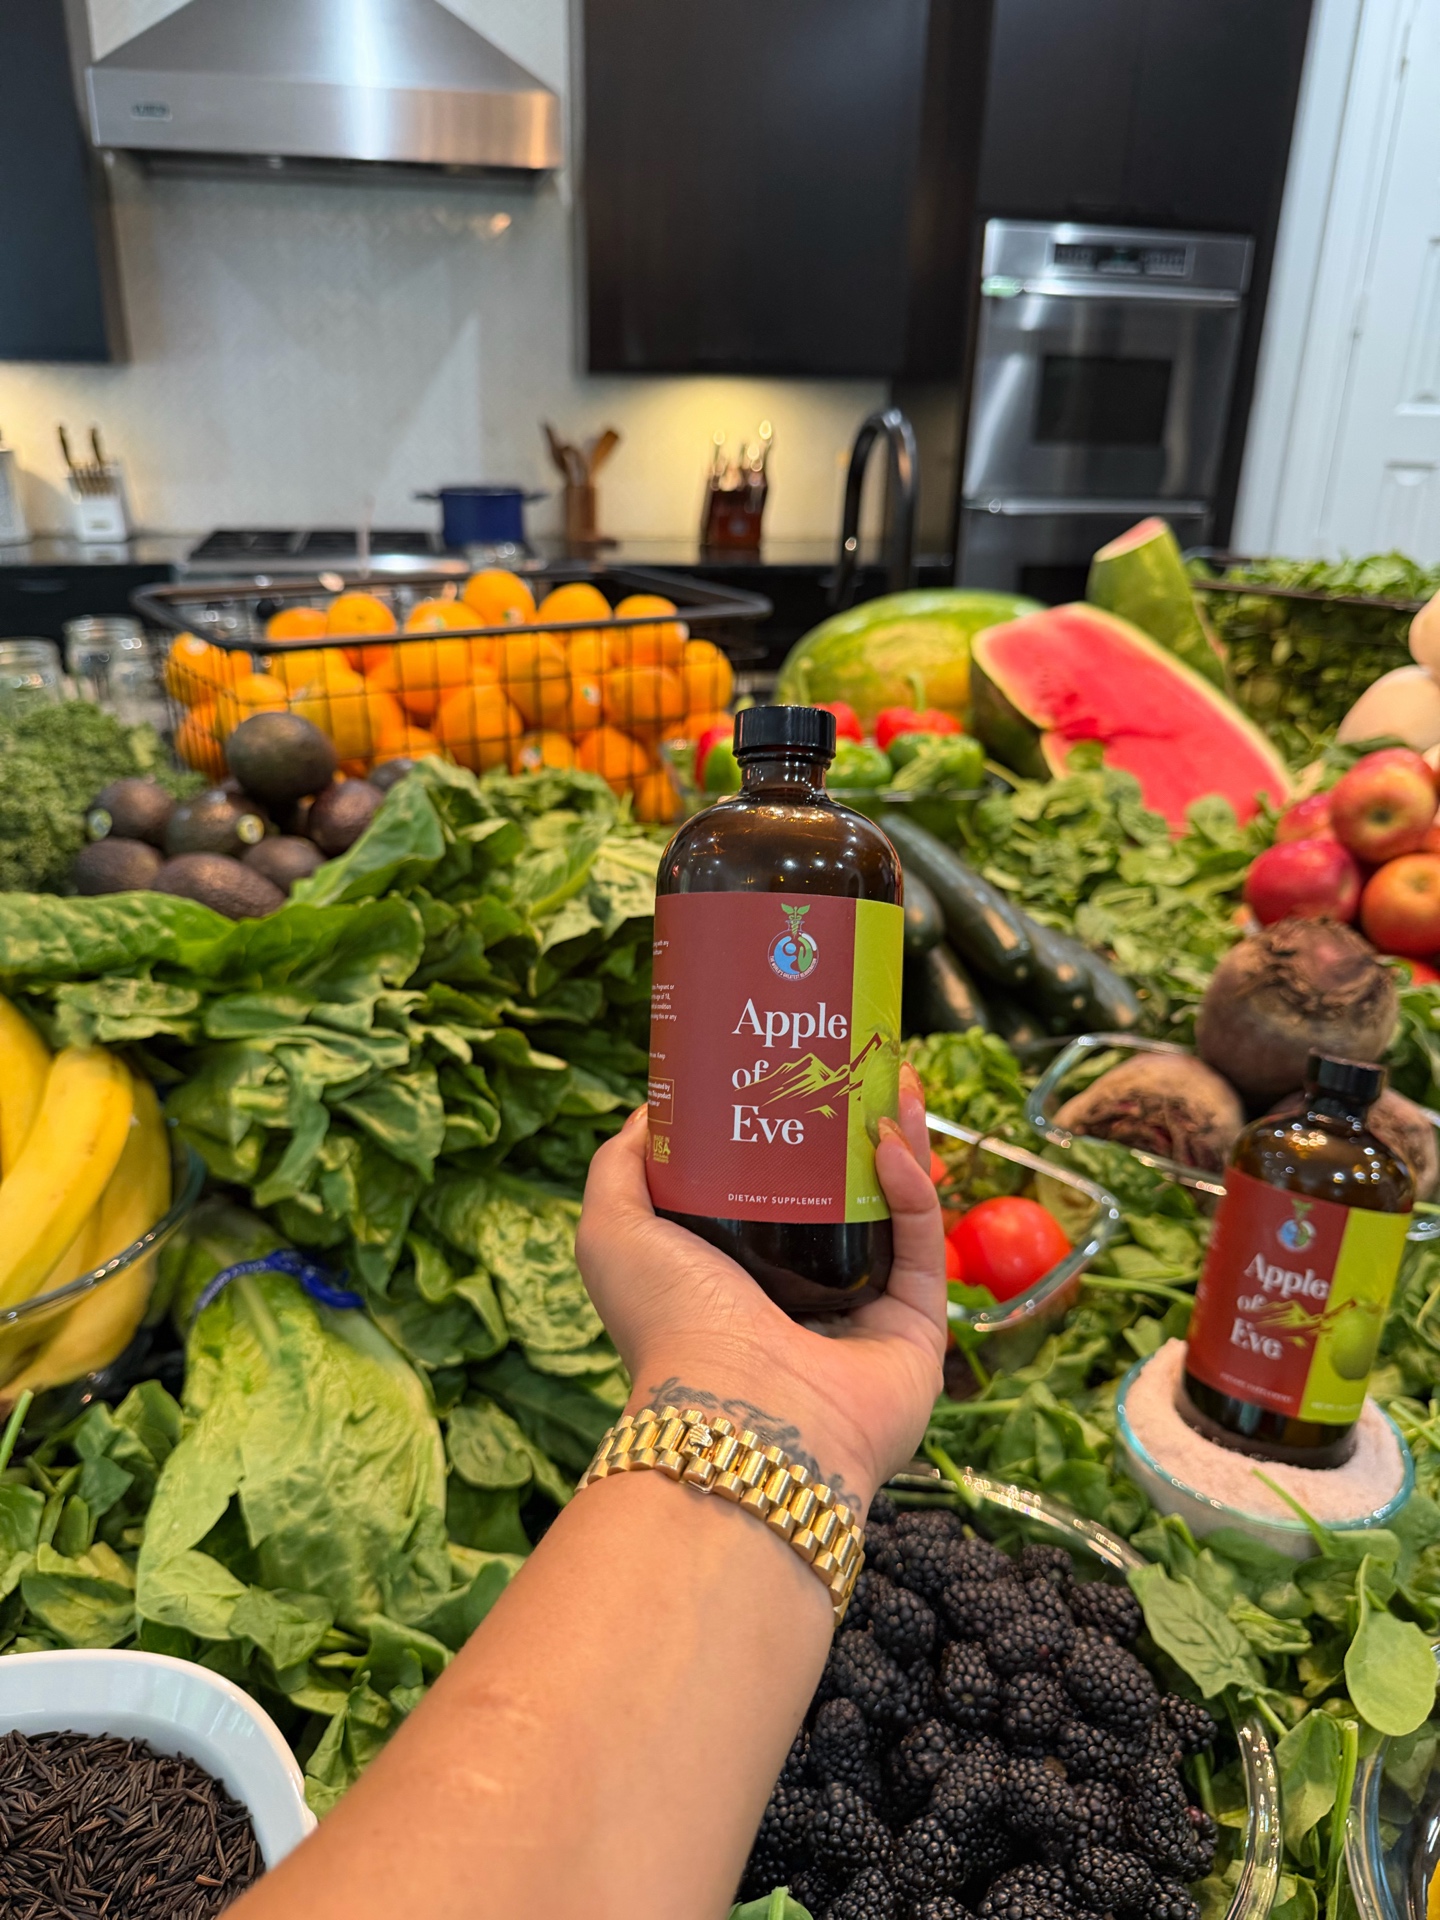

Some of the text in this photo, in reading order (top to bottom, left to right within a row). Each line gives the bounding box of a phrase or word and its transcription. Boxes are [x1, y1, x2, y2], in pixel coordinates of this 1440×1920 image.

[731, 998, 848, 1049] Apple
[731, 1059, 770, 1091] of
[730, 1104, 804, 1145] Eve
[653, 1140, 670, 1155] USA
[727, 1193, 833, 1206] DIETARY SUPPLEMENT
[856, 1196, 870, 1204] NET
[1243, 1252, 1330, 1301] Apple
[1236, 1294, 1267, 1313] of
[1230, 1317, 1283, 1360] Eve
